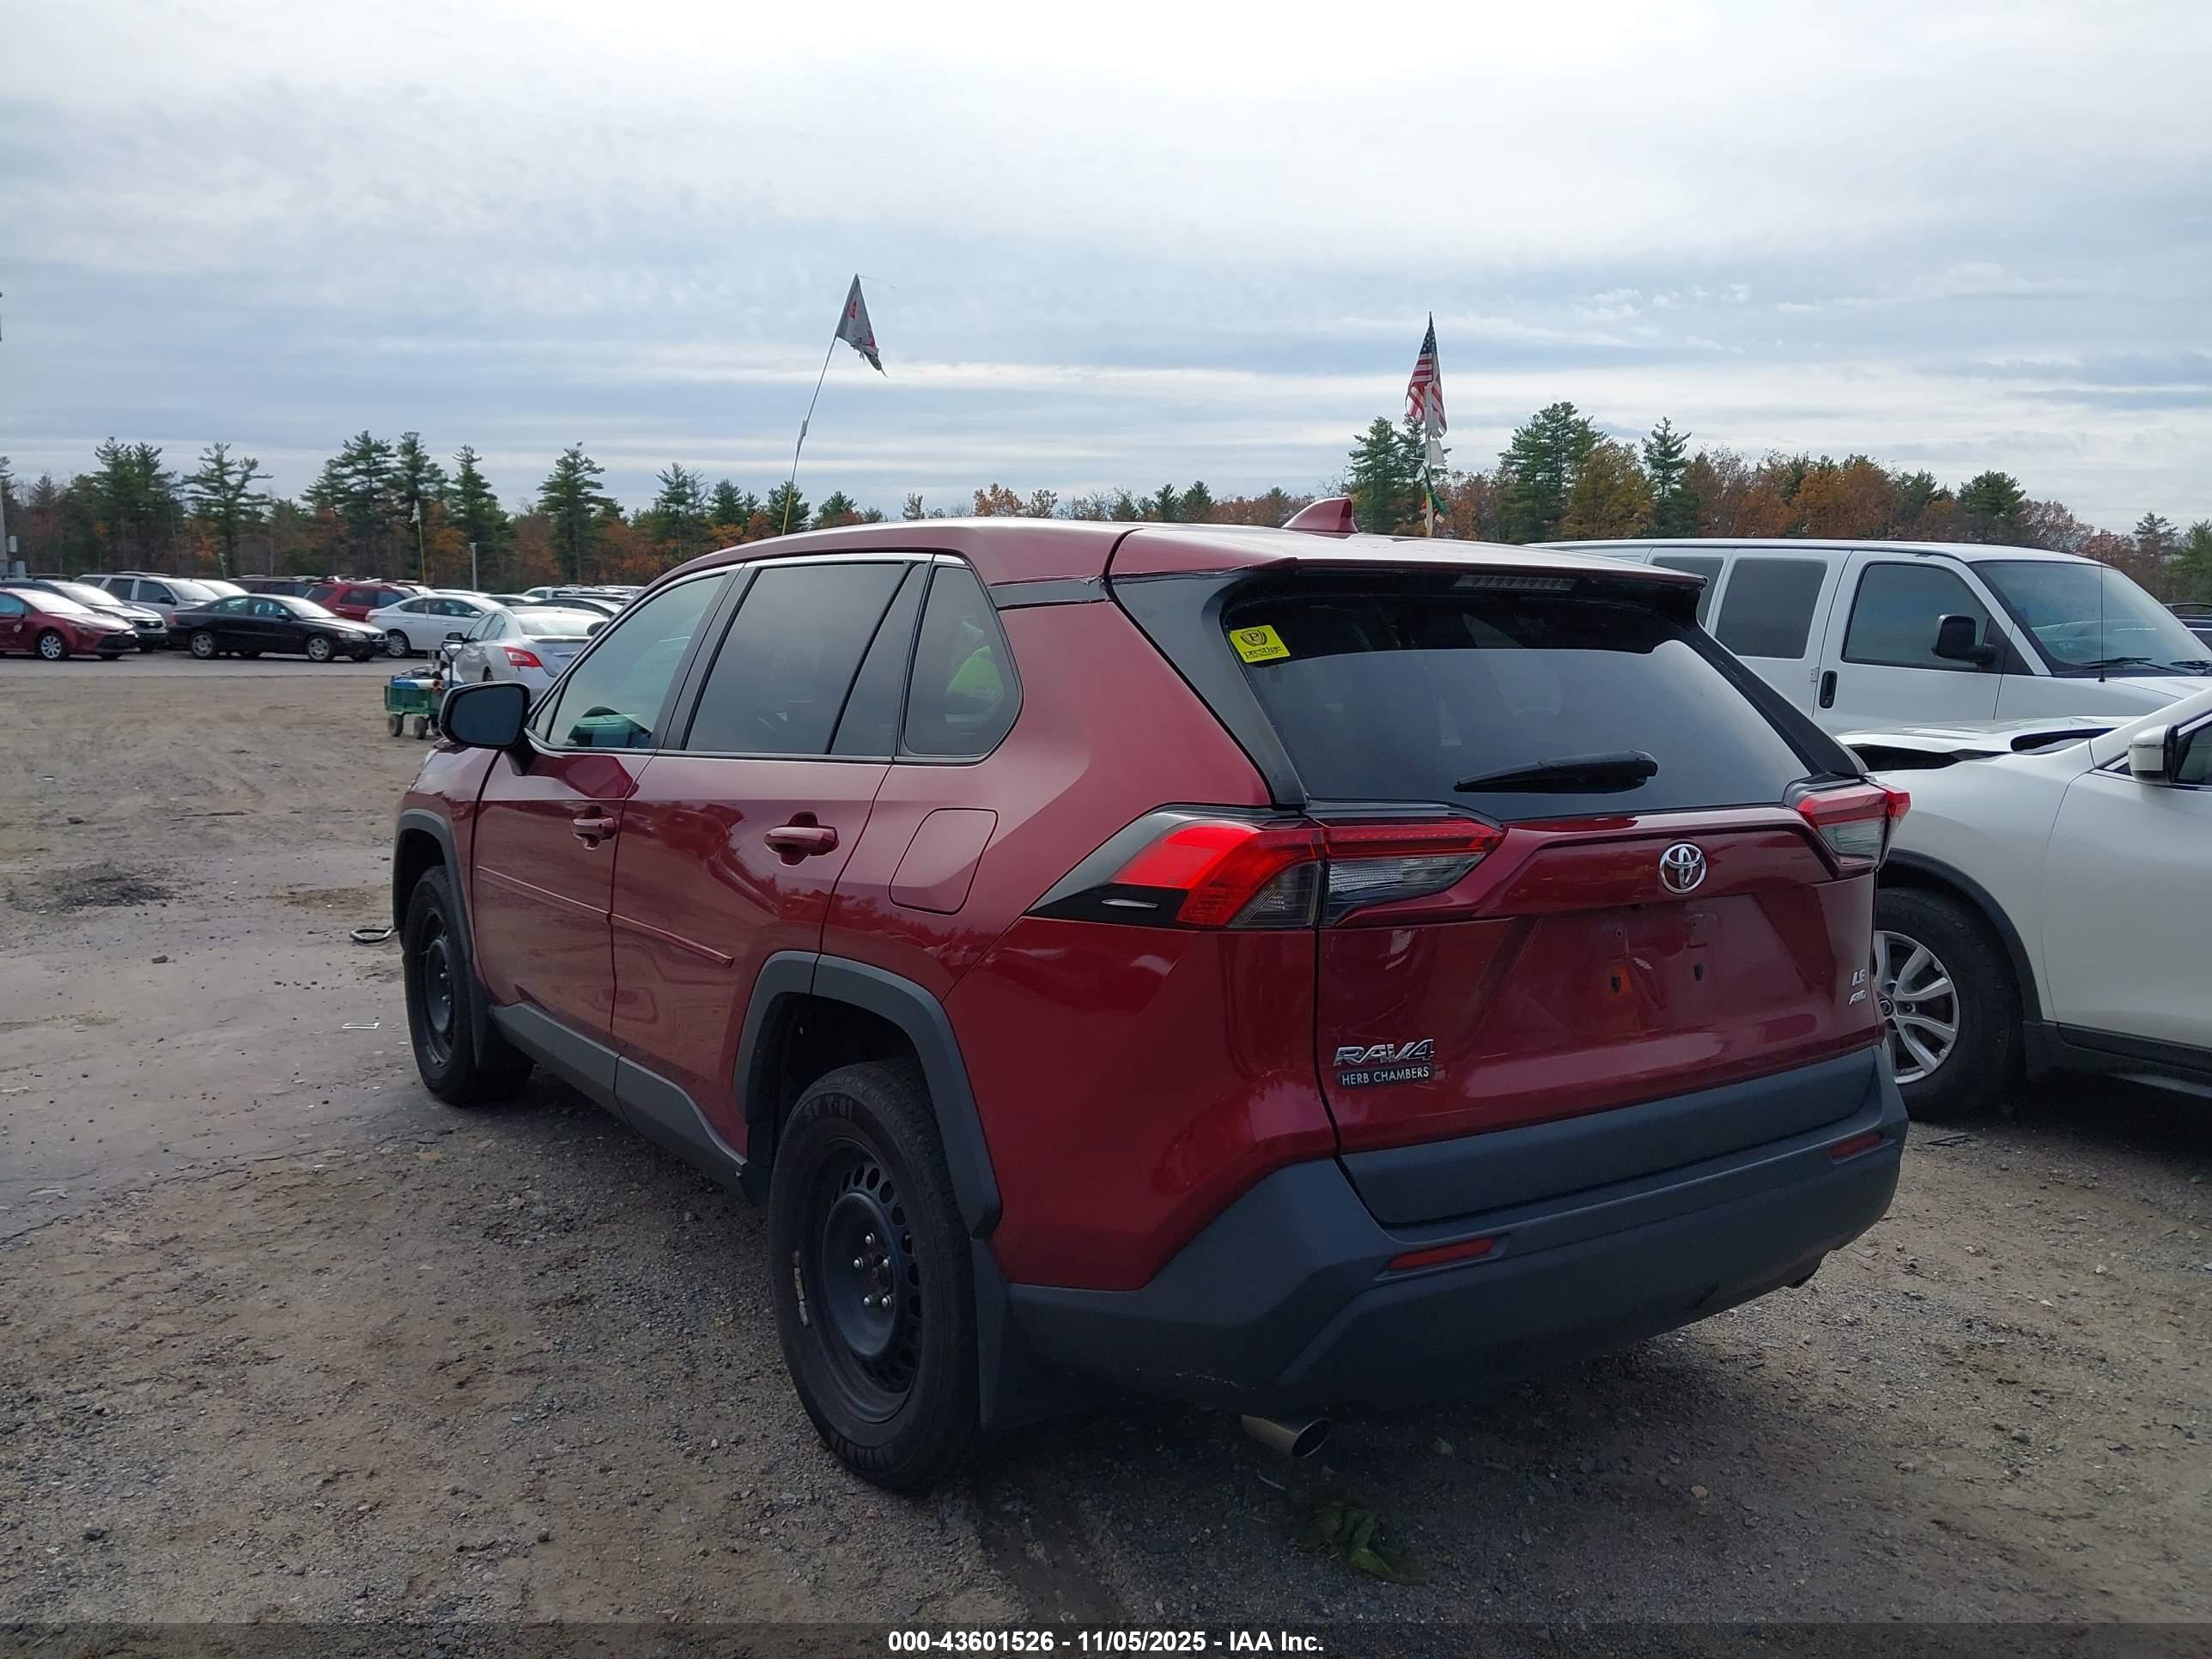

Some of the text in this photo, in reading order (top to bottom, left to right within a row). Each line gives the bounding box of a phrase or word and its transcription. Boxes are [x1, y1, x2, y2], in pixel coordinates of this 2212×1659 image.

[1851, 969, 1866, 986] LE
[1333, 1039, 1435, 1066] RAV4
[1341, 1066, 1429, 1085] HERB CHAMBERS
